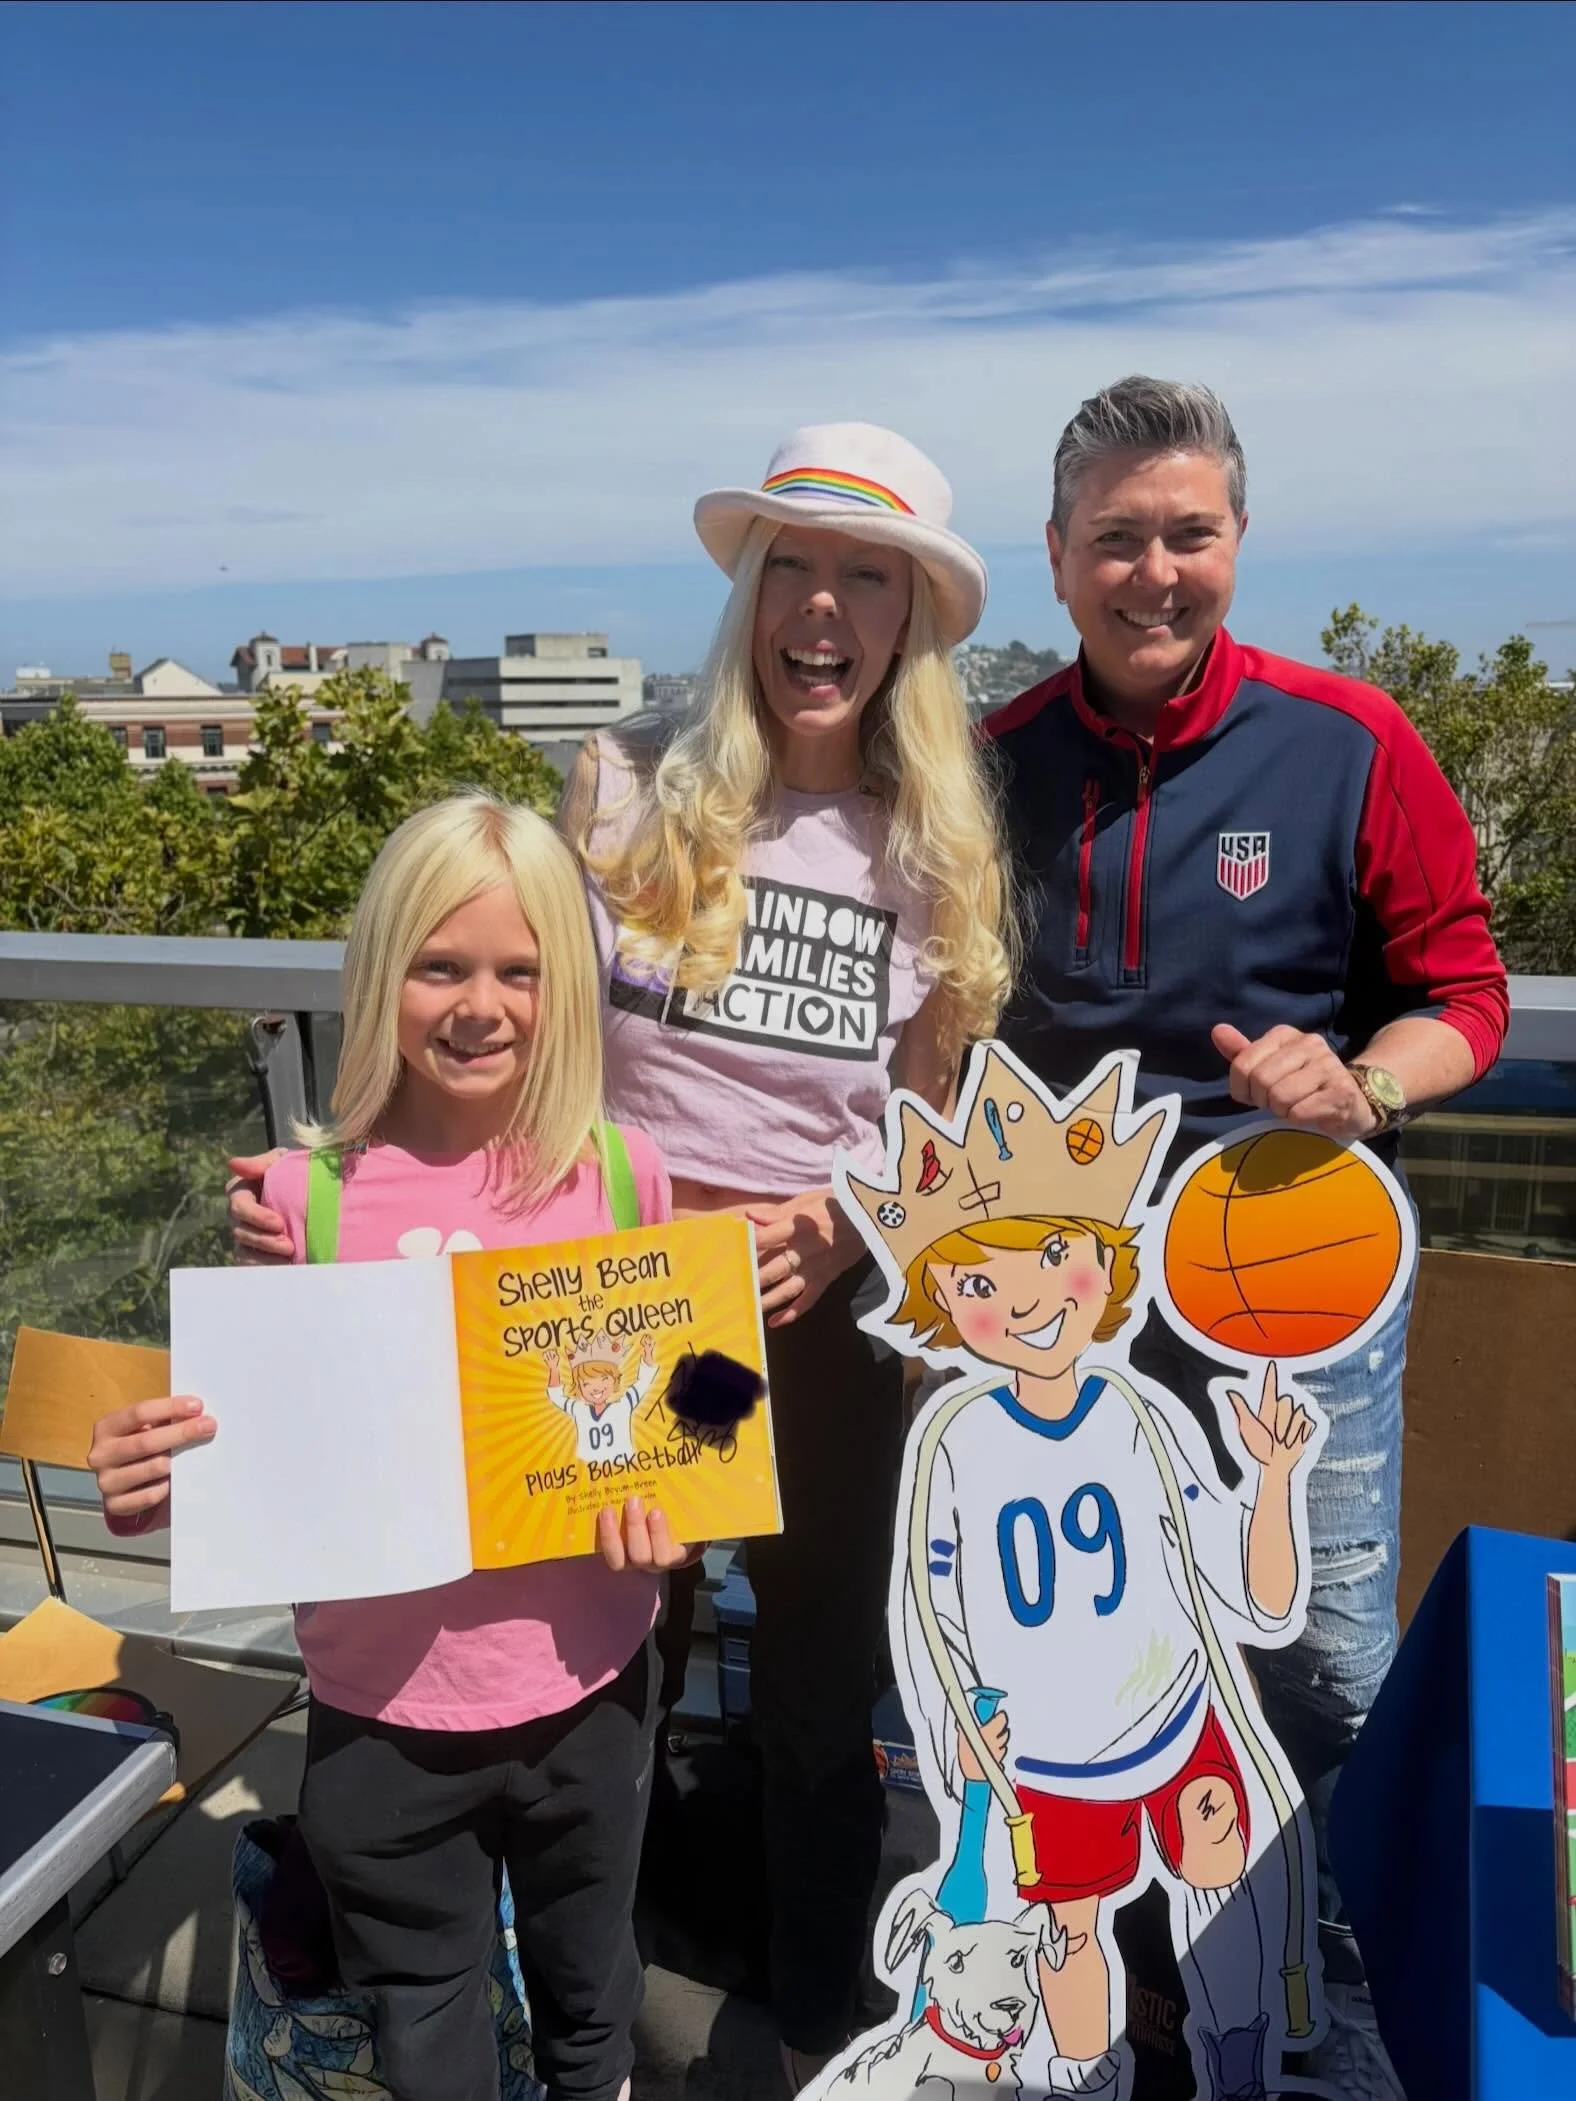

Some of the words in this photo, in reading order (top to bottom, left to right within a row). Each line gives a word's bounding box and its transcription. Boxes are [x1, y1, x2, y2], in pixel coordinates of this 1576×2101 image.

[1221, 835, 1267, 862] USA
[745, 888, 885, 957] INBOW
[736, 934, 876, 998] MILIES
[497, 1264, 583, 1306] Shelly
[596, 1250, 671, 1289] Bean
[578, 1292, 604, 1313] the
[503, 1314, 595, 1358] Sports
[605, 1297, 693, 1338] Queen
[588, 1423, 615, 1450] 09
[525, 1464, 578, 1496] Plays
[588, 1441, 699, 1482] Basketball
[996, 1481, 1127, 1628] 09
